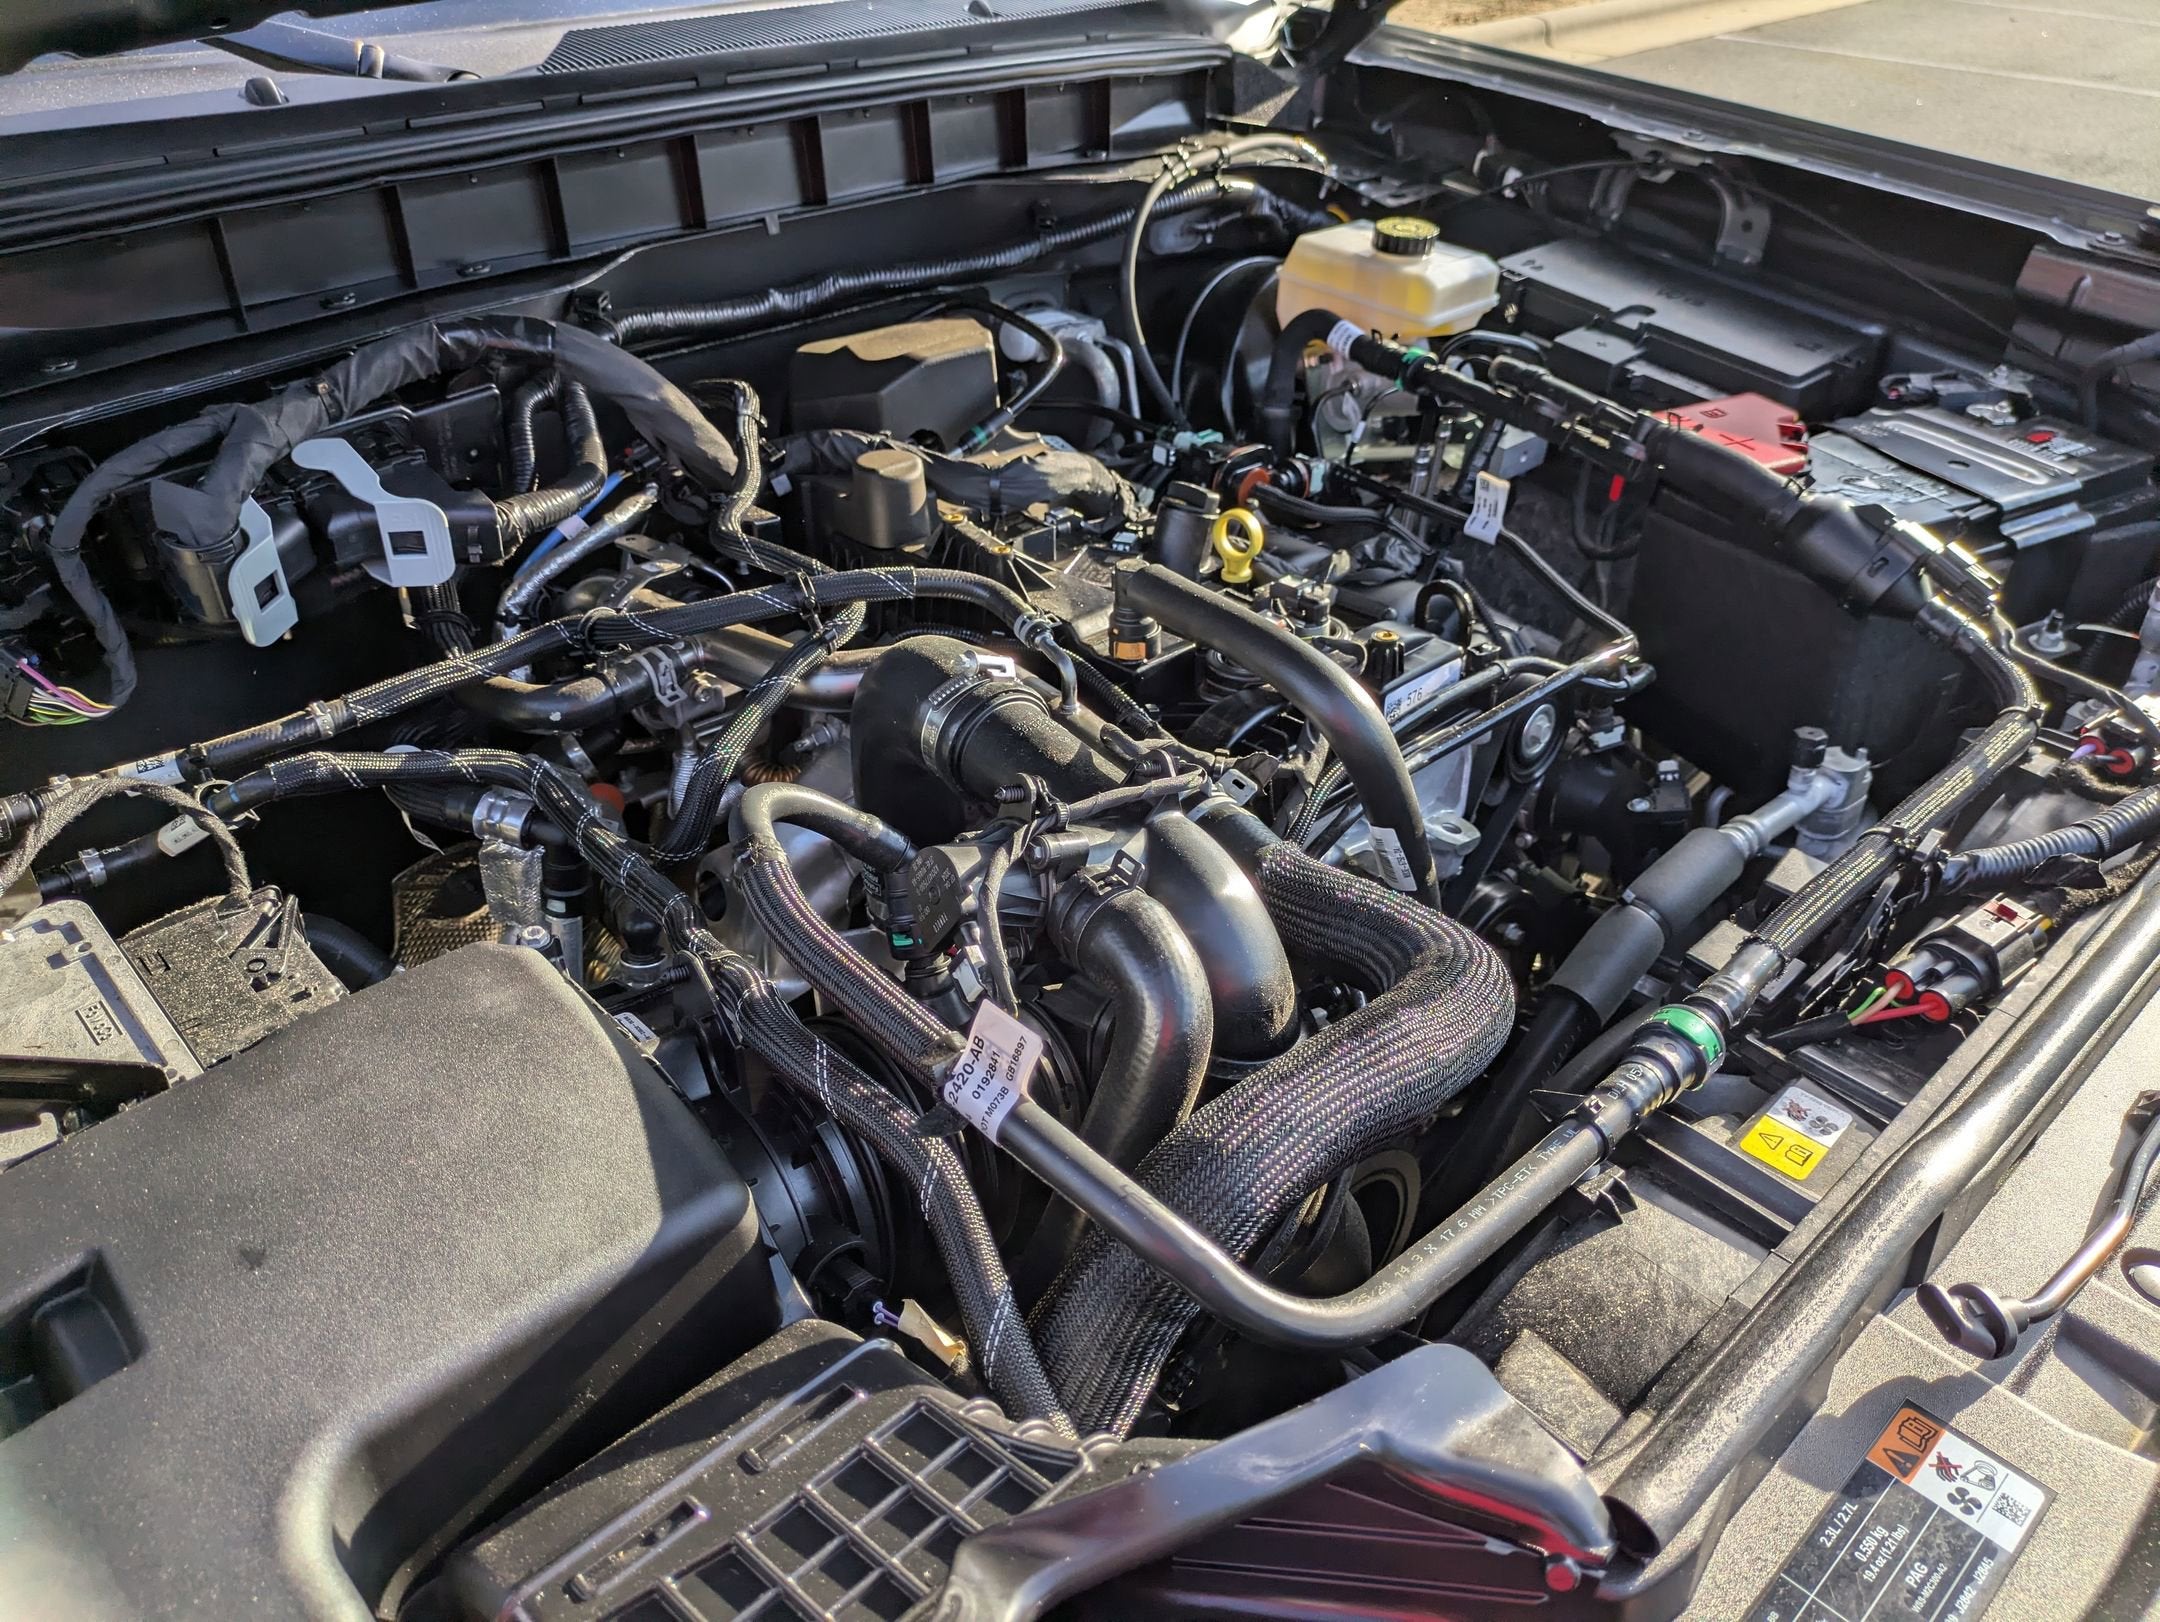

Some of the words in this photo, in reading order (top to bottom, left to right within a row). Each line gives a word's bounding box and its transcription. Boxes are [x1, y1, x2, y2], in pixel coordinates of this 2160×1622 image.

[1407, 688, 1422, 706] 576
[948, 1035, 985, 1105] 2420-AB
[971, 1051, 1001, 1100] 0192841
[979, 1117, 991, 1135] OT
[989, 1086, 1010, 1118] M073B
[1006, 1035, 1028, 1082] GB16897
[1424, 1243, 1438, 1255] X
[1468, 1204, 1487, 1220] MM
[1820, 1526, 1841, 1548] 2.3L
[1838, 1502, 1859, 1523] 2.7L
[1854, 1535, 1878, 1563] 0.550
[1870, 1525, 1889, 1541] kg
[1891, 1523, 1910, 1541] lbs)
[1876, 1554, 1887, 1568] oz
[1880, 1538, 1897, 1560] (1.21
[1863, 1560, 1879, 1583] 19.4
[1905, 1561, 1929, 1588] PAG
[1954, 1585, 1977, 1615] J2842
[1972, 1556, 1994, 1585] J2845
